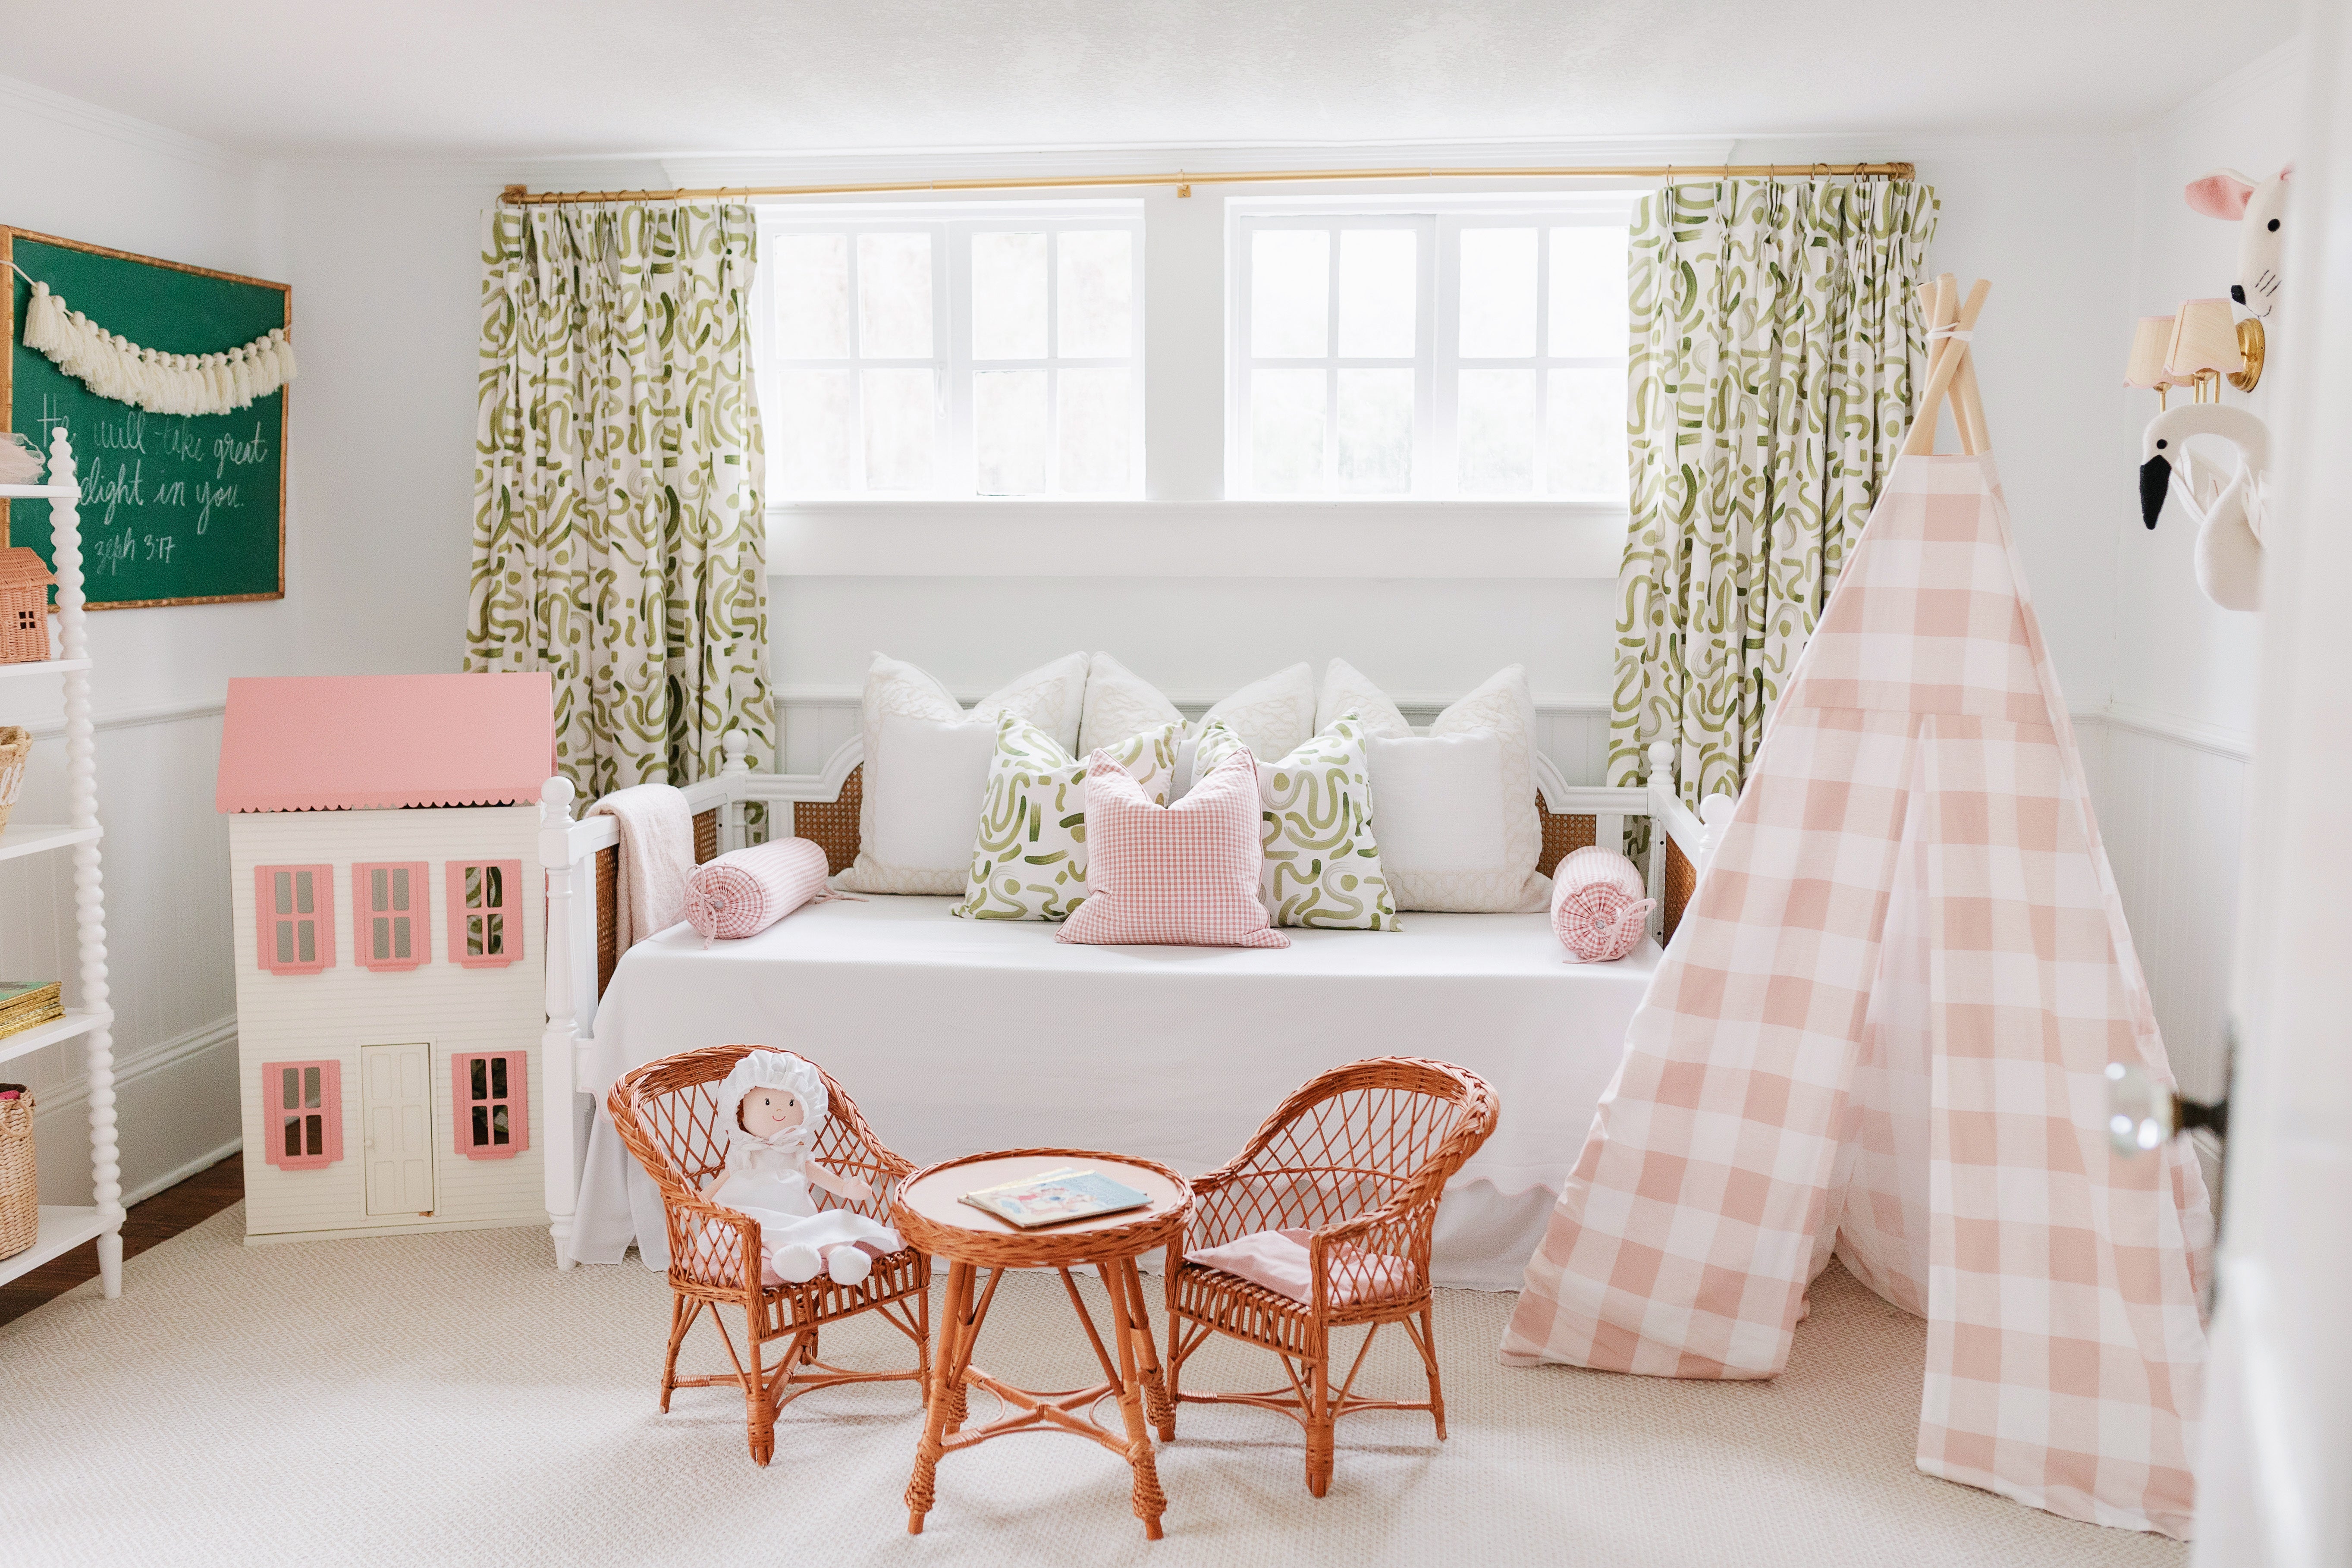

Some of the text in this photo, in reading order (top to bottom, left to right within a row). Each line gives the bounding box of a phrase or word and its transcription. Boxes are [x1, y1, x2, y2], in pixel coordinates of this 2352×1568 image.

[94, 411, 146, 454] will
[155, 415, 205, 462] take
[214, 421, 268, 480] great
[72, 456, 244, 535] elight in you.
[144, 534, 175, 563] 3:17
